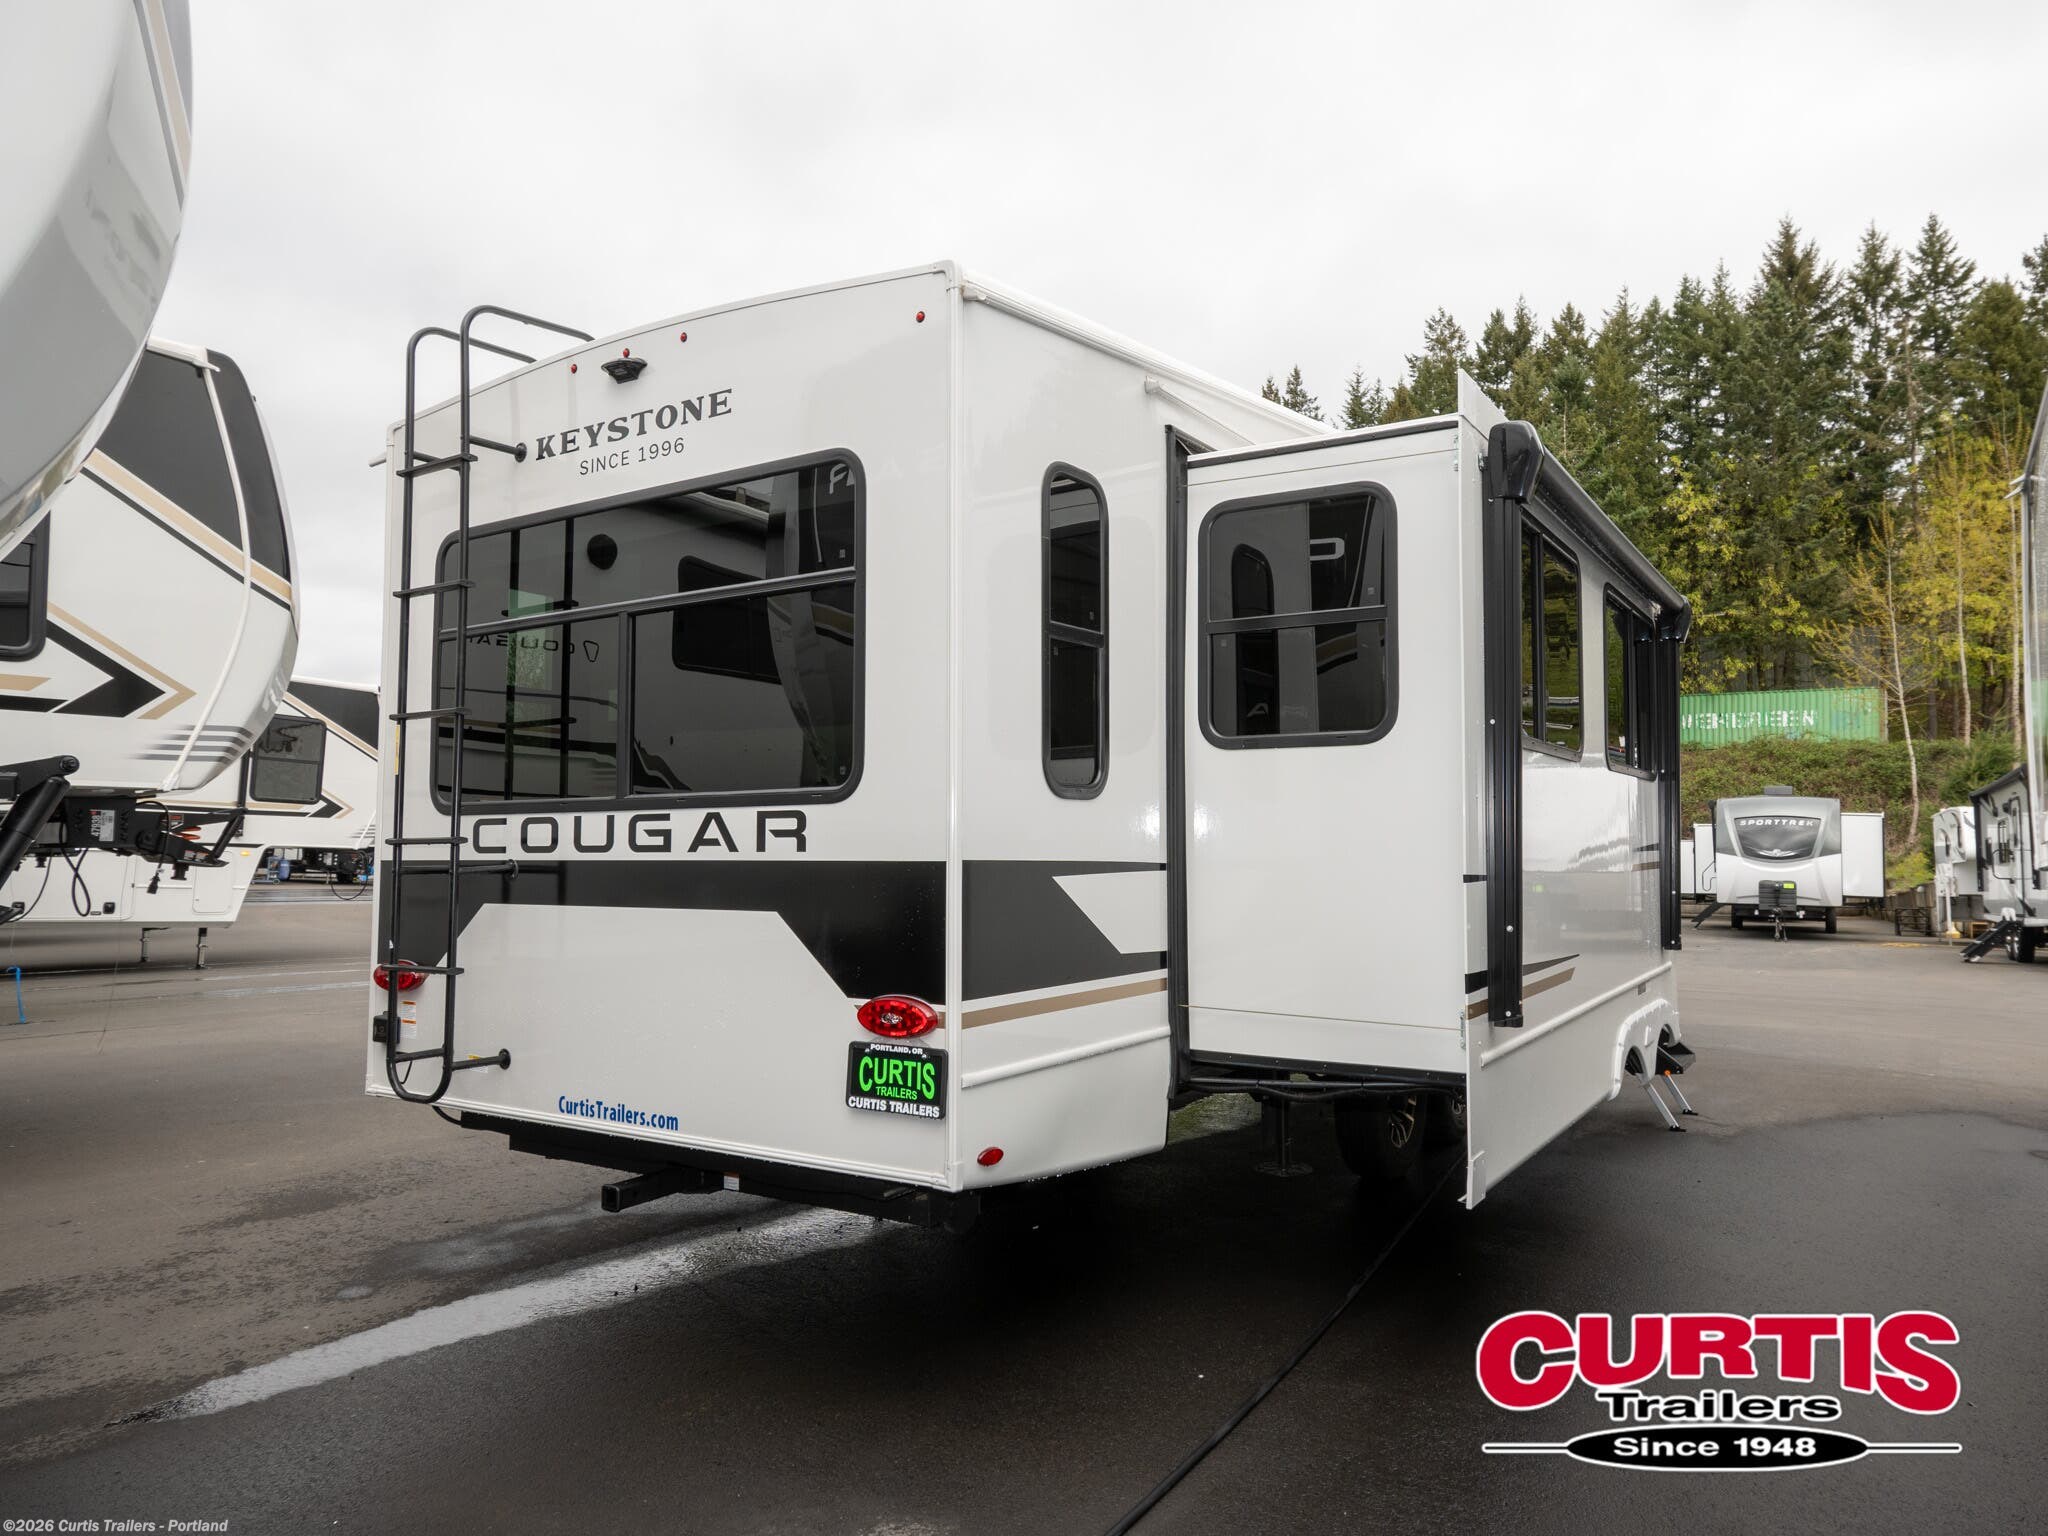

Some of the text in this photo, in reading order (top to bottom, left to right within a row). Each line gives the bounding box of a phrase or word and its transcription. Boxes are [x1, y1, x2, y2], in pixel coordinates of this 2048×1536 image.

[535, 388, 733, 461] KEYSTONE
[578, 437, 685, 476] SINCE 1996
[473, 810, 807, 854] COUGAR
[1740, 819, 1814, 827] SPORTTREK
[870, 1043, 911, 1054] PORTLAND,
[859, 1056, 935, 1100] CURTIS
[876, 1086, 918, 1101] TRAILERS
[558, 1095, 679, 1131] CurtisTrailers.com
[848, 1096, 940, 1118] CURTIS TRAILERS
